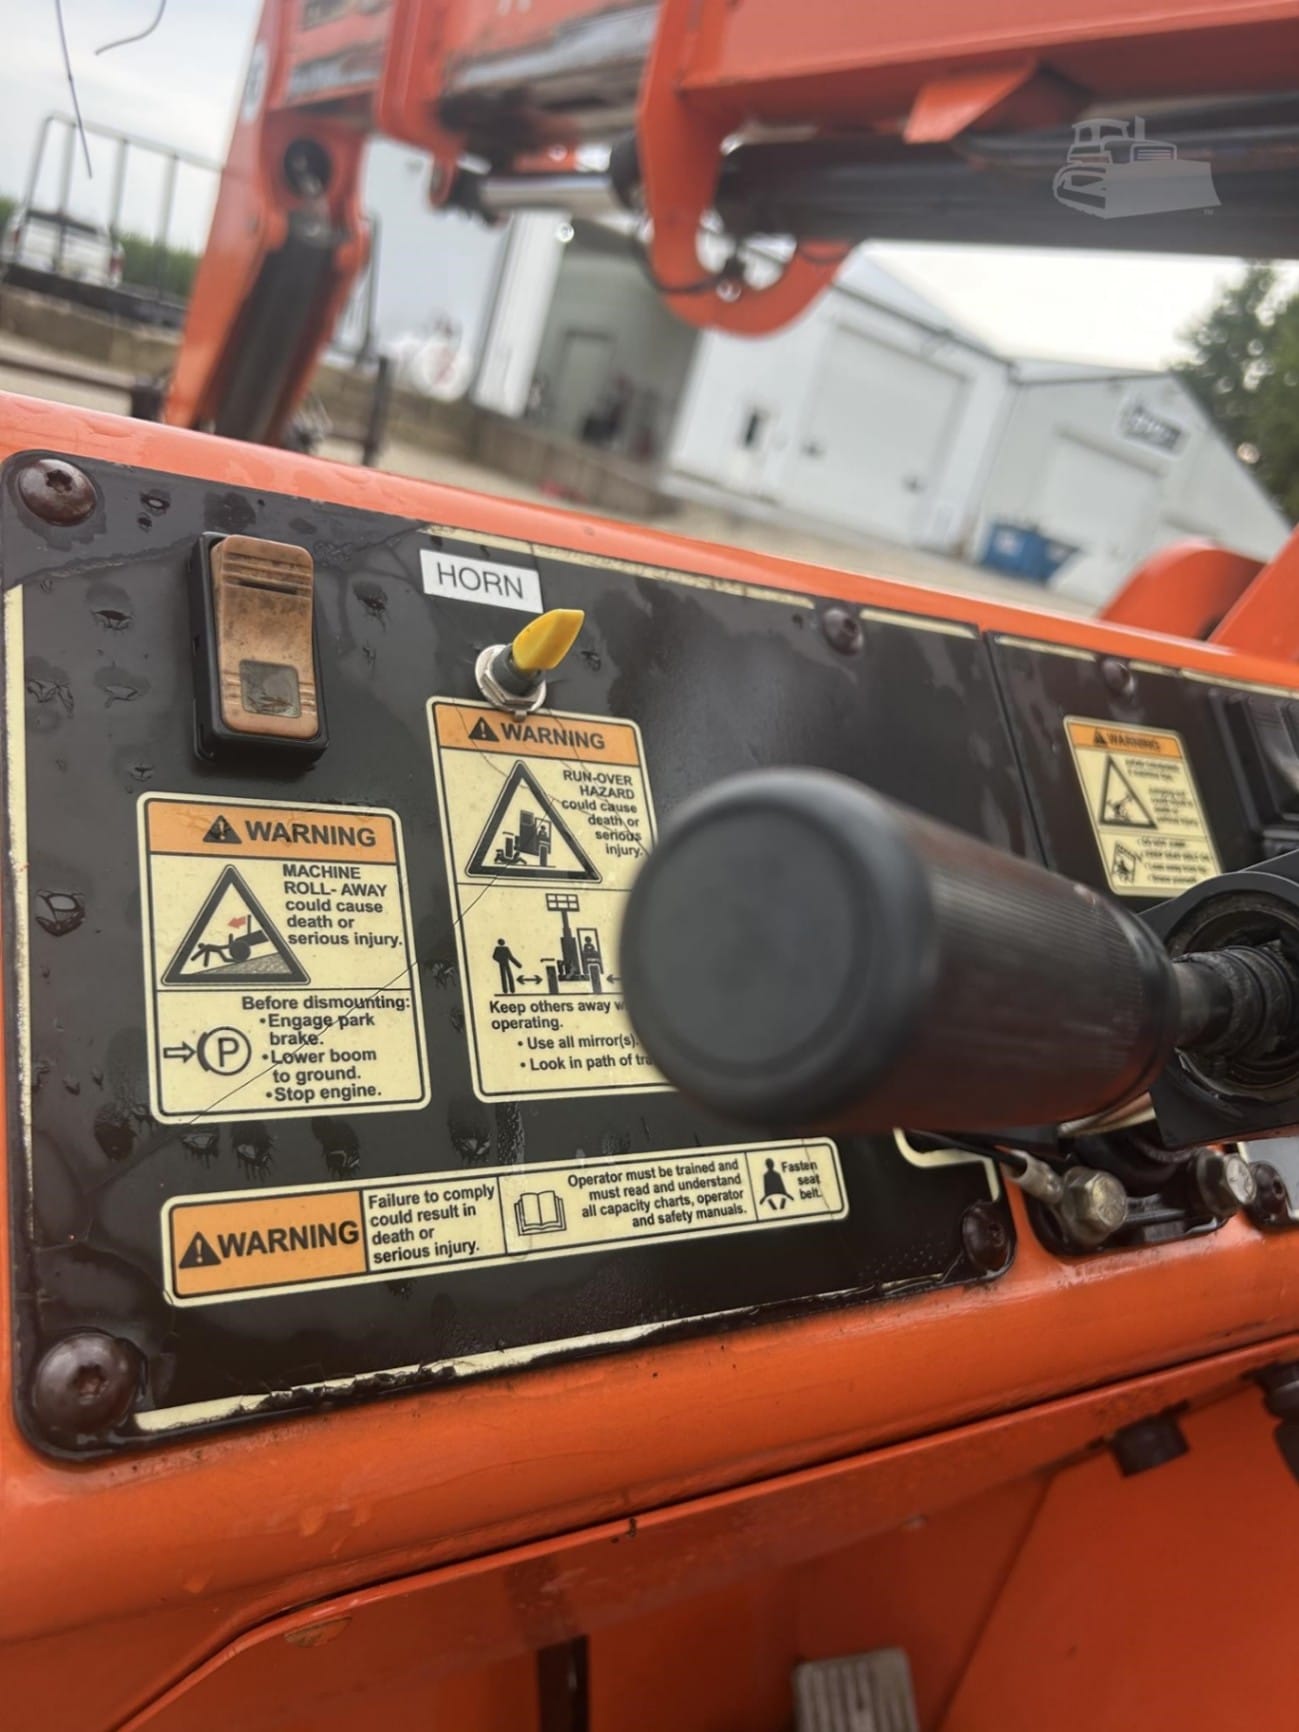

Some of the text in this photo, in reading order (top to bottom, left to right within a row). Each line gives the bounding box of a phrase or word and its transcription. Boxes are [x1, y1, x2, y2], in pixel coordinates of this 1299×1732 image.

[437, 562, 523, 600] HORN
[500, 722, 605, 750] WARNING
[563, 770, 633, 786] RUN-OVER
[580, 785, 635, 799] HAZARD
[561, 800, 638, 813] could cause
[588, 814, 640, 827] death or
[245, 820, 376, 847] WARNING
[595, 830, 642, 842] serious
[606, 843, 644, 858] injury.
[283, 864, 361, 879] MACHINE
[341, 883, 387, 897] AWAY
[286, 898, 383, 913] could cause
[287, 915, 355, 928] death or
[289, 932, 403, 948] serious injury.
[242, 995, 410, 1011] Before dismounting:
[489, 1000, 526, 1015] Keep
[530, 999, 574, 1014] others
[578, 1001, 610, 1014] away
[268, 1013, 375, 1030] Engage park
[491, 1016, 563, 1032] operating.
[270, 1032, 324, 1046] brake.
[527, 1037, 555, 1050] Use
[557, 1036, 575, 1049] all
[271, 1049, 376, 1065] Lower boom
[530, 1057, 566, 1071] Look
[569, 1056, 583, 1069] in
[586, 1054, 616, 1071] path
[619, 1053, 632, 1066] of
[273, 1066, 361, 1085] to ground.
[274, 1084, 382, 1103] Stop engine.
[568, 1159, 739, 1188] Operator must be trained and
[781, 1160, 817, 1173] Fasten
[589, 1173, 742, 1200] must read and understand
[797, 1174, 820, 1186] seat
[368, 1184, 494, 1209] Failure to comply
[582, 1189, 743, 1218] all capacity charts, operator
[371, 1203, 476, 1227] could result in
[632, 1203, 747, 1227] and safety manuals.
[217, 1220, 359, 1259] WARNING
[372, 1228, 435, 1245] death or
[374, 1240, 479, 1264] serious injury.
